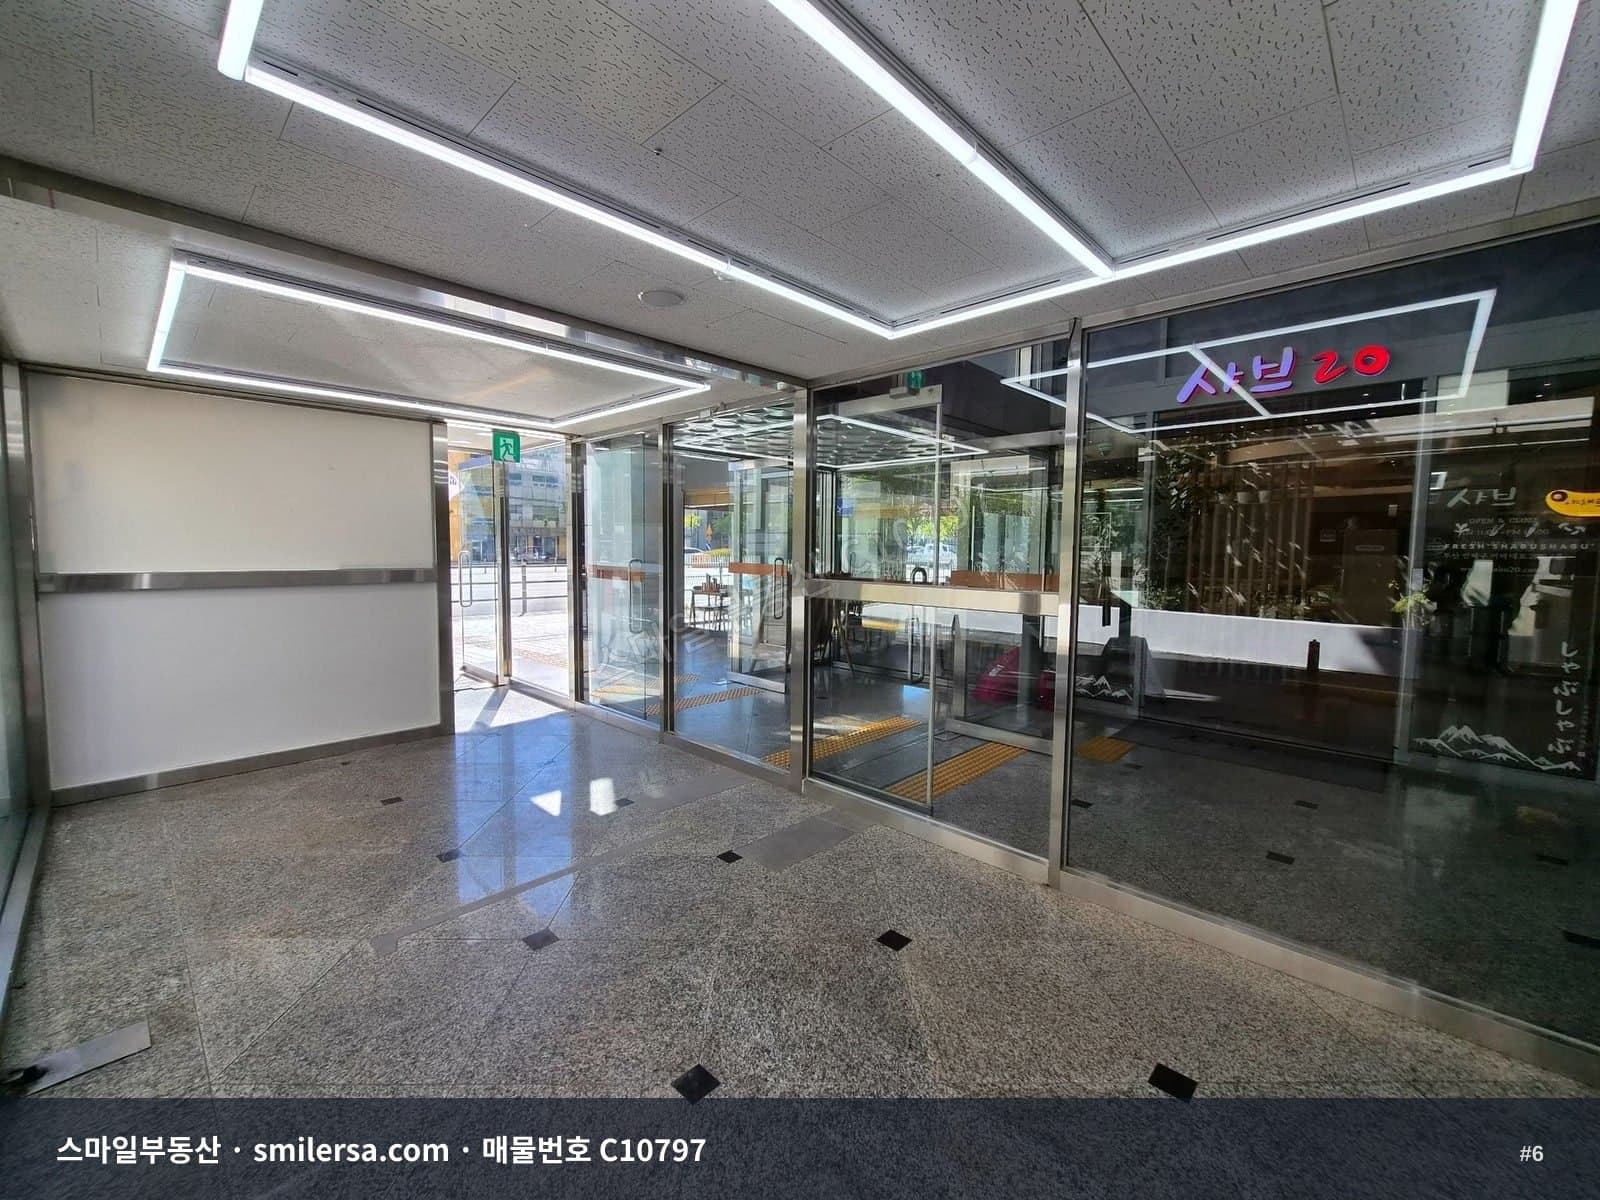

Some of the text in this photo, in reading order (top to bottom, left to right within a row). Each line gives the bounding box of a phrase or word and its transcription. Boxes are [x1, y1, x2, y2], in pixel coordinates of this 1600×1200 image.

[1176, 344, 1391, 404] 샤브 20
[1447, 487, 1518, 508] 샤브
[1547, 641, 1581, 755] しゃぶしゃぶ
